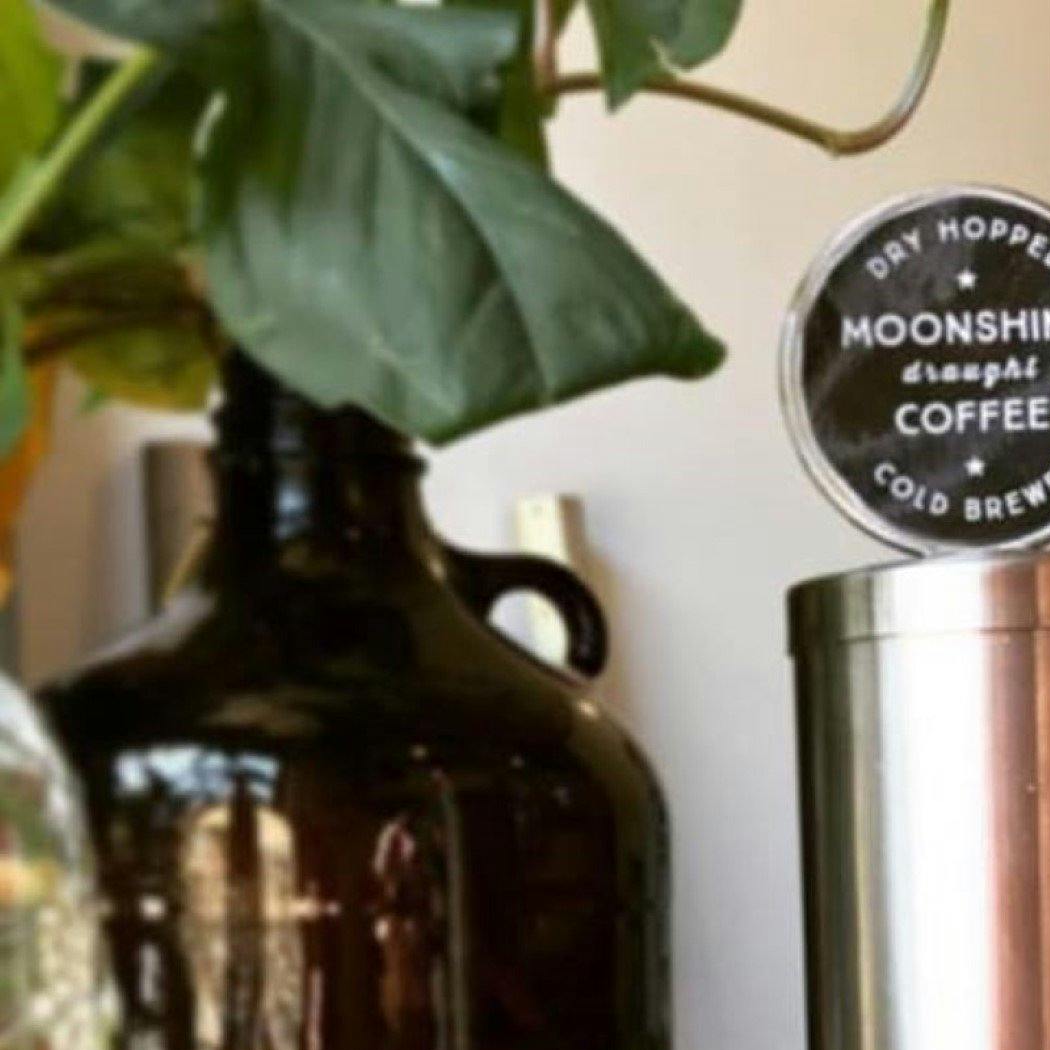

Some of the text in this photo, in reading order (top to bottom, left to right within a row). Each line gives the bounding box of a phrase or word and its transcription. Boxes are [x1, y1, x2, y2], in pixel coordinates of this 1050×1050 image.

[866, 229, 922, 280] DRY
[902, 353, 1040, 389] draught
[895, 397, 1050, 435] COFFEE
[873, 462, 949, 515] COLD
